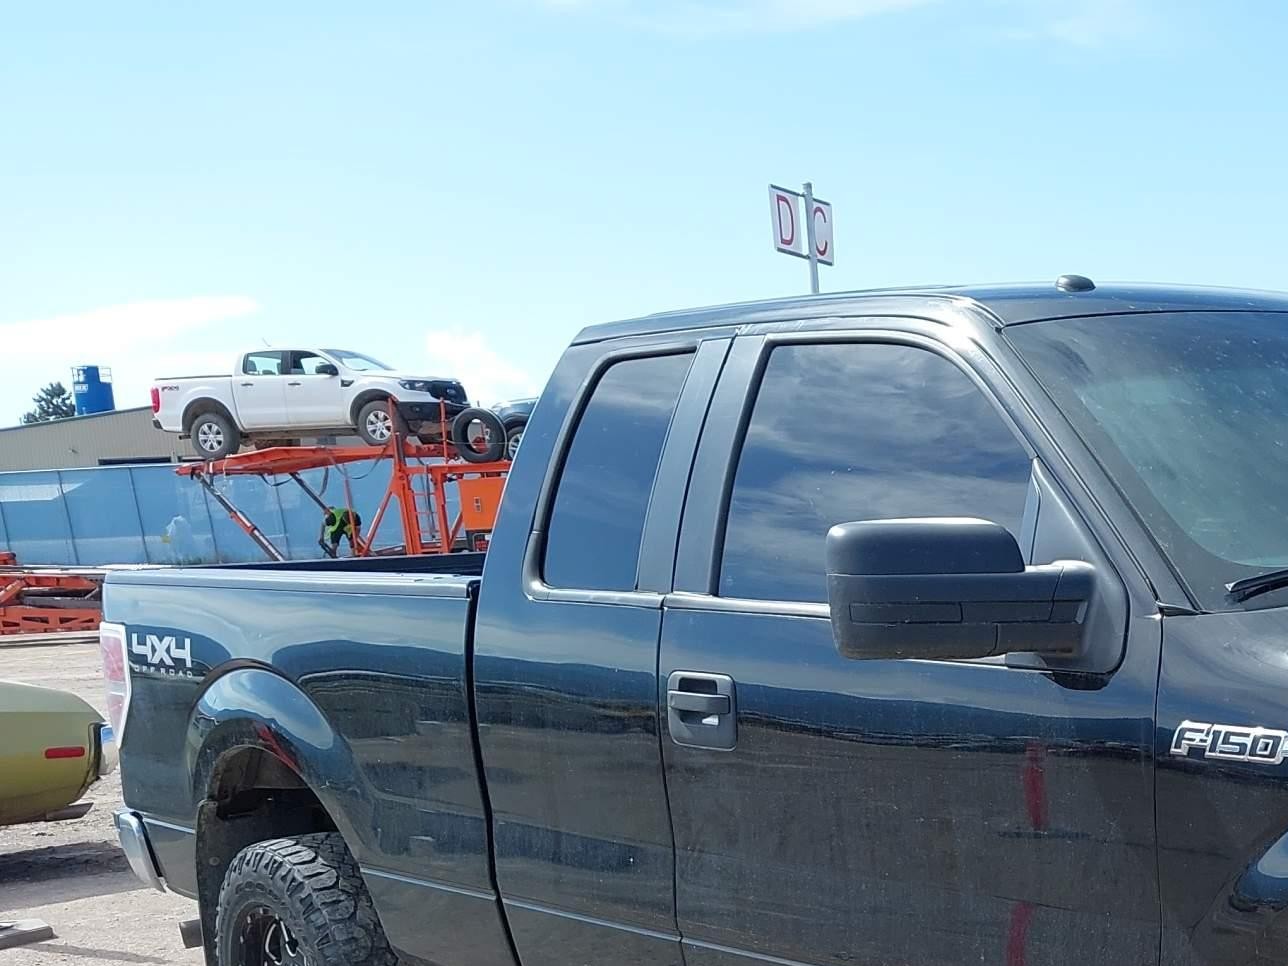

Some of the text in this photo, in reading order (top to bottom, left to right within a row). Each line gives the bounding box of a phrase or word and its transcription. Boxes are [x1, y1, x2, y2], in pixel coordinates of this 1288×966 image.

[776, 194, 795, 246] D
[813, 206, 828, 256] C
[131, 632, 192, 668] 4X4
[134, 665, 193, 679] OFF ROAD
